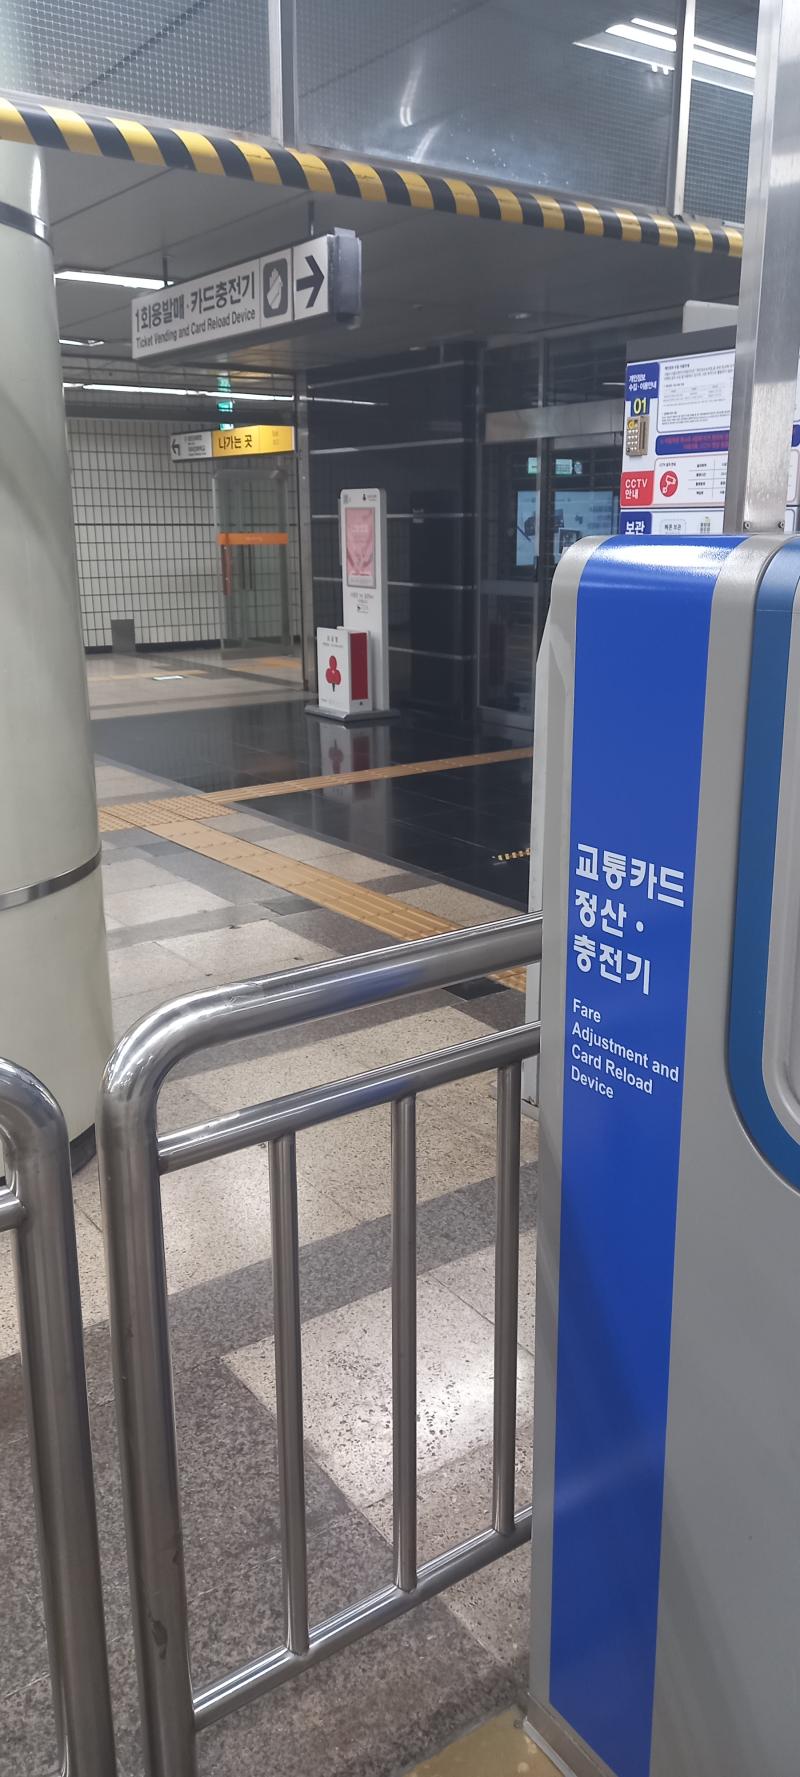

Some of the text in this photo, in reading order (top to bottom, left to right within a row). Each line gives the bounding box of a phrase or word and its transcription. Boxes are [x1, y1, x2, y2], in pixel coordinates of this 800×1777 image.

[136, 307, 255, 349] Ticket Vending and Card Reload Device
[633, 397, 647, 415] 01
[218, 436, 241, 450] 나가는
[244, 434, 253, 448] 곳
[625, 478, 648, 489] CCTV
[625, 488, 639, 500] 안내
[625, 520, 646, 535] 보관
[575, 843, 685, 908] 교통카드
[573, 934, 651, 995] 충전기
[573, 998, 601, 1023] Fare
[572, 1022, 680, 1083] Adjustment and
[571, 1065, 615, 1099] Device
[572, 1043, 653, 1095] Card Reload
